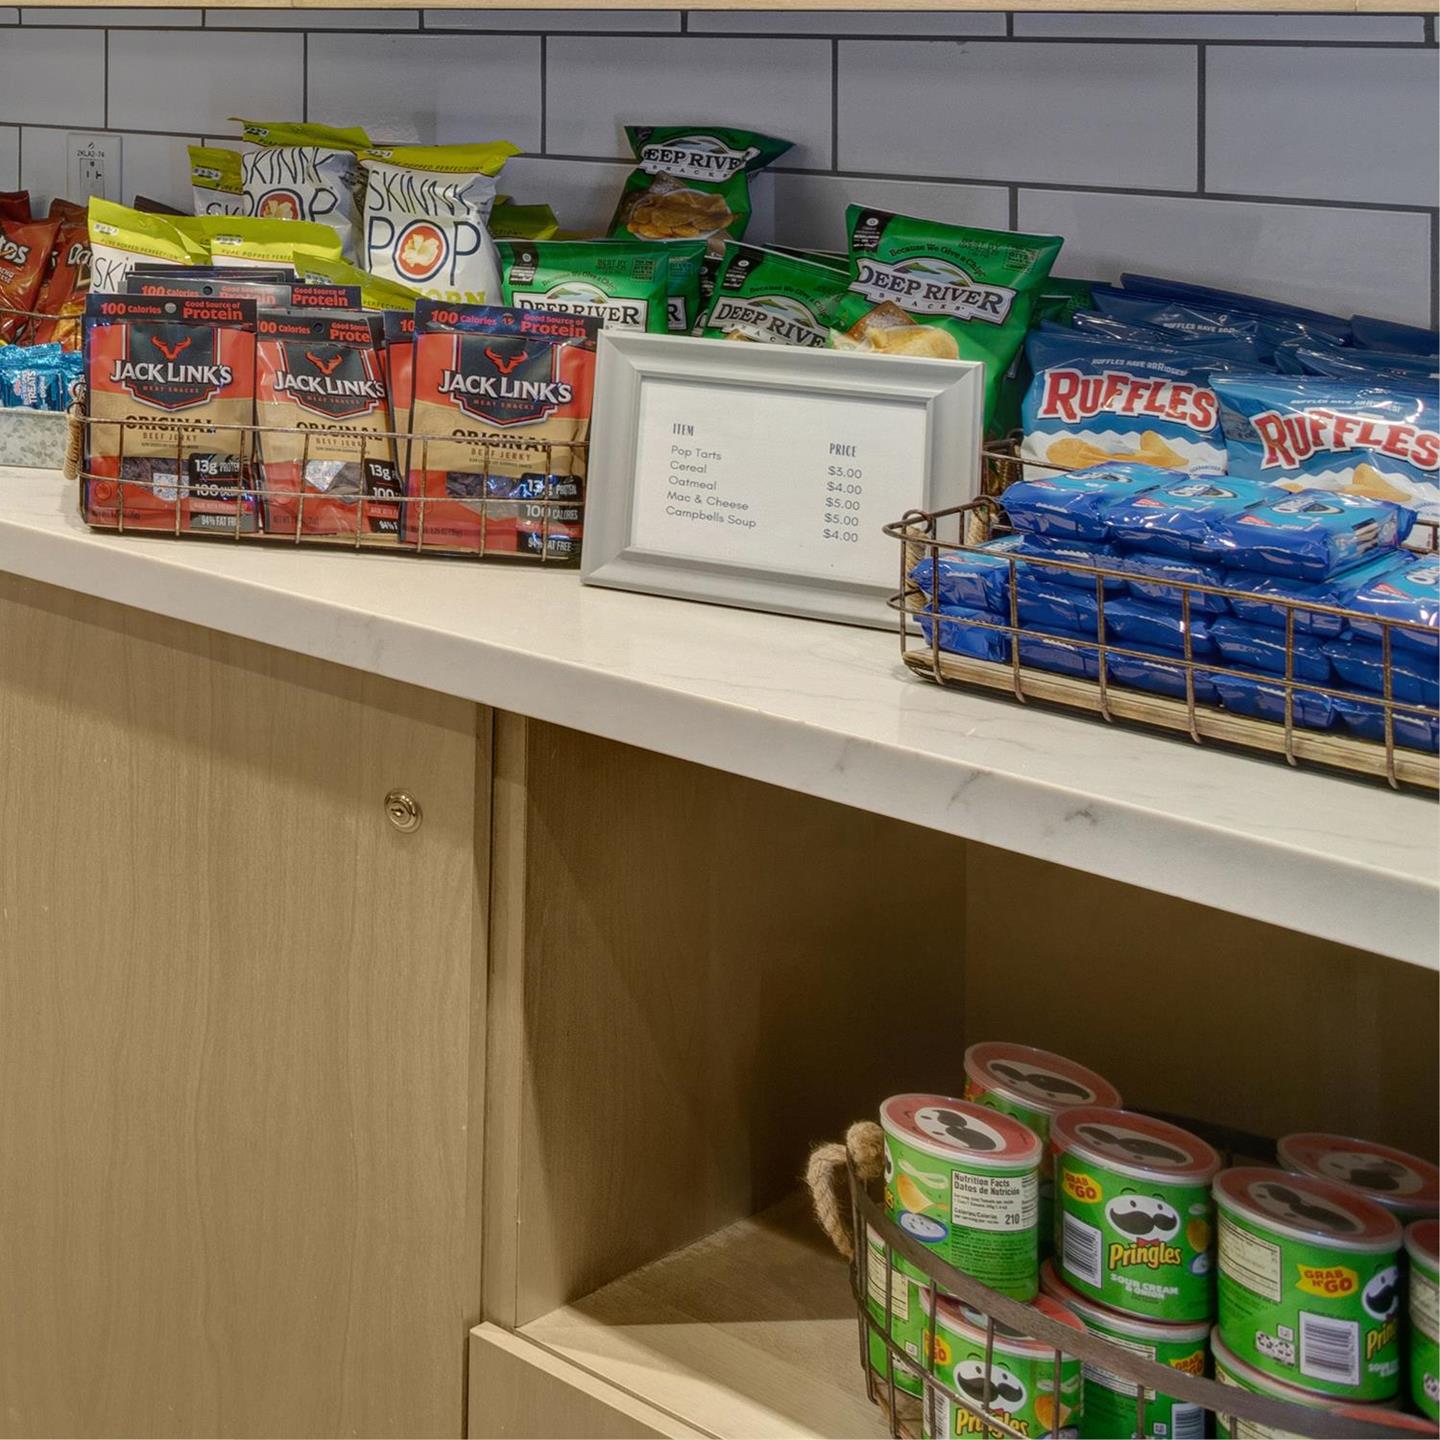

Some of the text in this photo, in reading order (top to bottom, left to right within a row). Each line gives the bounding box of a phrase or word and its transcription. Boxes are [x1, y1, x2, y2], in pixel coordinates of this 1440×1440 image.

[369, 169, 474, 217] SKINNY
[368, 216, 482, 286] POP
[889, 243, 959, 257] Because We Give
[140, 285, 166, 297] 100
[293, 287, 347, 296] Good Source of
[861, 263, 1004, 316] DEEP RIVER
[184, 300, 240, 309] Good Source of
[292, 293, 349, 307] Protein
[100, 302, 162, 315] 100 Calories
[183, 308, 243, 321] Protein
[567, 300, 640, 325] RIVER
[716, 302, 762, 330] DEEP
[431, 309, 497, 326] 100 Calories
[524, 313, 546, 323] Good
[521, 321, 586, 338] Protein
[109, 359, 165, 384] JACK
[166, 362, 233, 386] LINK'S
[274, 369, 386, 398] JACK LINK'S
[437, 368, 572, 403] JACK LINK'S
[1042, 370, 1218, 430] RUFFLES
[672, 422, 694, 437] ITEM
[1252, 409, 1440, 471] RUFFLES
[671, 444, 722, 460] Pop Tarts
[829, 442, 857, 457] PRICE
[194, 459, 218, 475] 13g
[369, 463, 391, 480] 13g
[669, 460, 707, 474] Cereal
[827, 464, 863, 480] $3.00
[668, 475, 717, 491] Oatmeal
[826, 480, 863, 496] $4.00
[666, 491, 749, 511] Mac & Cheese
[825, 496, 861, 512] $5.00
[552, 509, 578, 520] CALORIES
[665, 505, 757, 530] Campbells Soup
[824, 512, 859, 528] $5.00
[822, 528, 859, 543] $4.00
[556, 541, 572, 552] FREE
[954, 1172, 1010, 1188] Nutrition Facts
[954, 1181, 989, 1195] Datos de
[1005, 1213, 1020, 1225] 210
[1107, 1242, 1183, 1271] Pringles
[1303, 1268, 1345, 1280] GRAB
[1136, 1280, 1179, 1296] CREAM
[1323, 1277, 1354, 1294] GO
